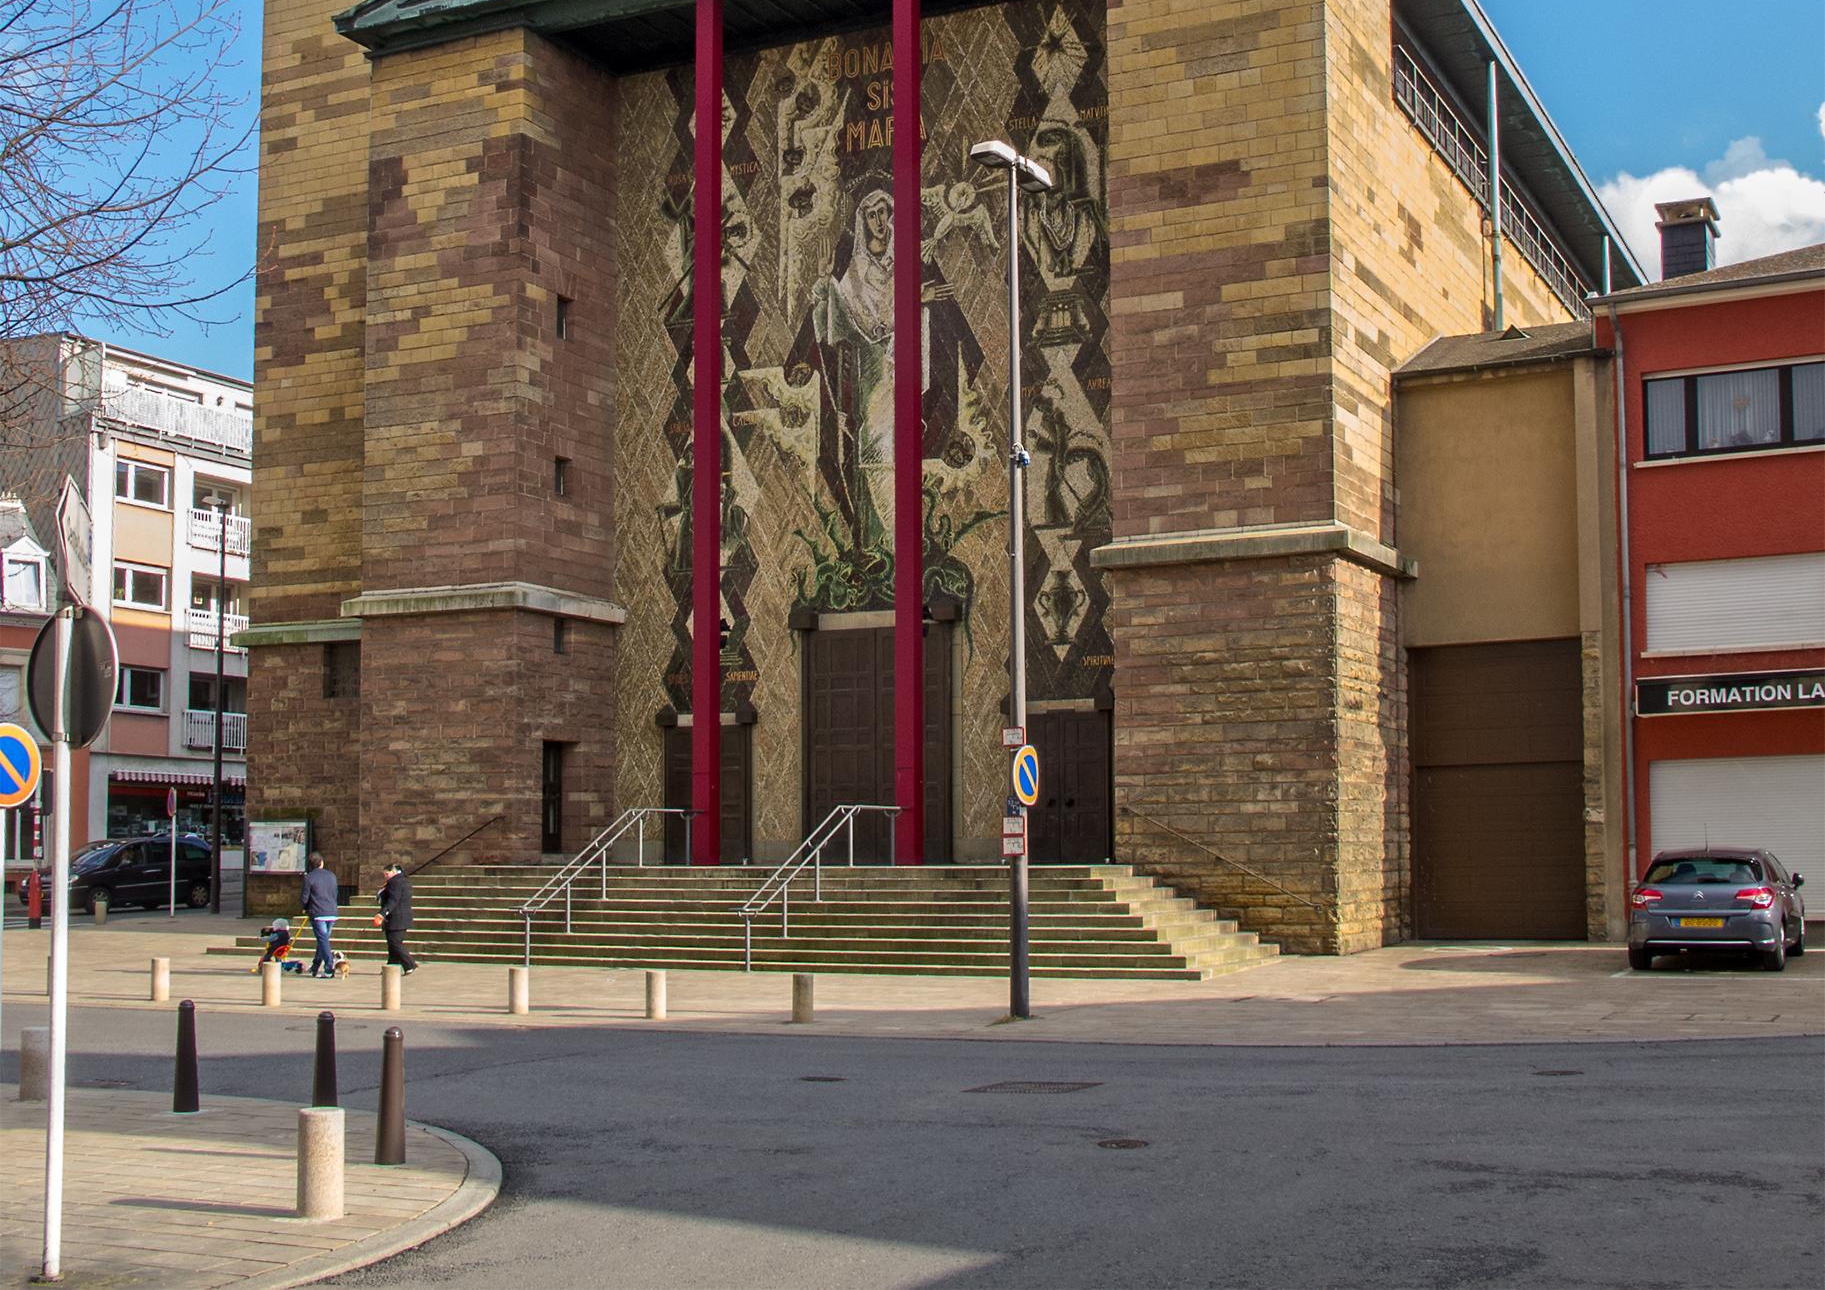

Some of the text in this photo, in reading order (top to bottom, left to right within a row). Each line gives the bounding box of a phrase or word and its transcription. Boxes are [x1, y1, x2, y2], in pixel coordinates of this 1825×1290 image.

[1008, 115, 1037, 131] STELLA
[730, 161, 760, 176] MYSTICA
[1667, 682, 1825, 707] FORMATION LA
